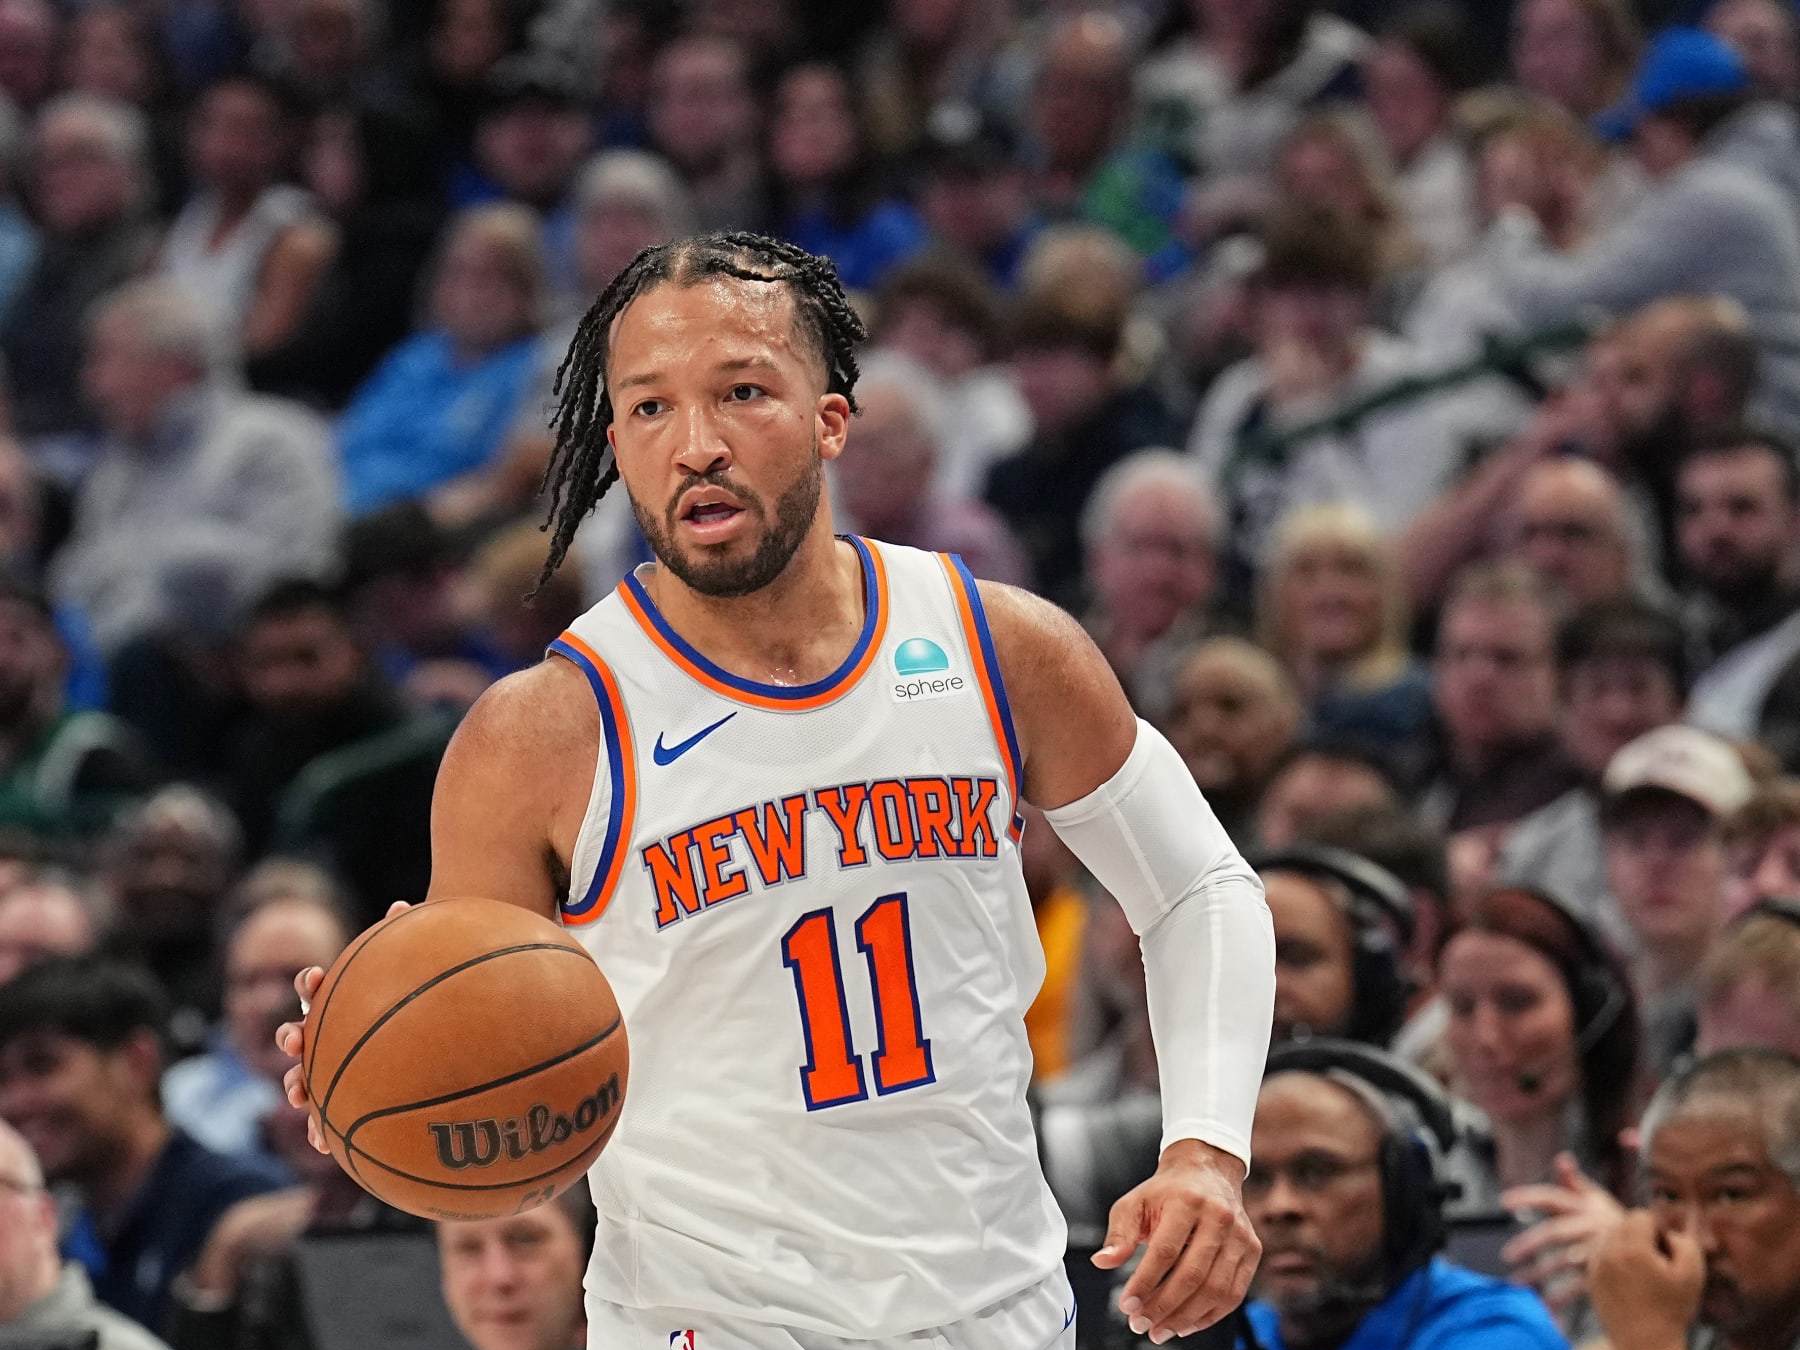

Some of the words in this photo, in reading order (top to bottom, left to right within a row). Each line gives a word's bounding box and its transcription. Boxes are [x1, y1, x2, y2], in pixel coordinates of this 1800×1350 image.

[894, 676, 964, 700] sphere
[642, 788, 811, 933] NEW
[813, 774, 1000, 871] YORK
[780, 891, 937, 1113] 11
[427, 1071, 621, 1171] Wilson
